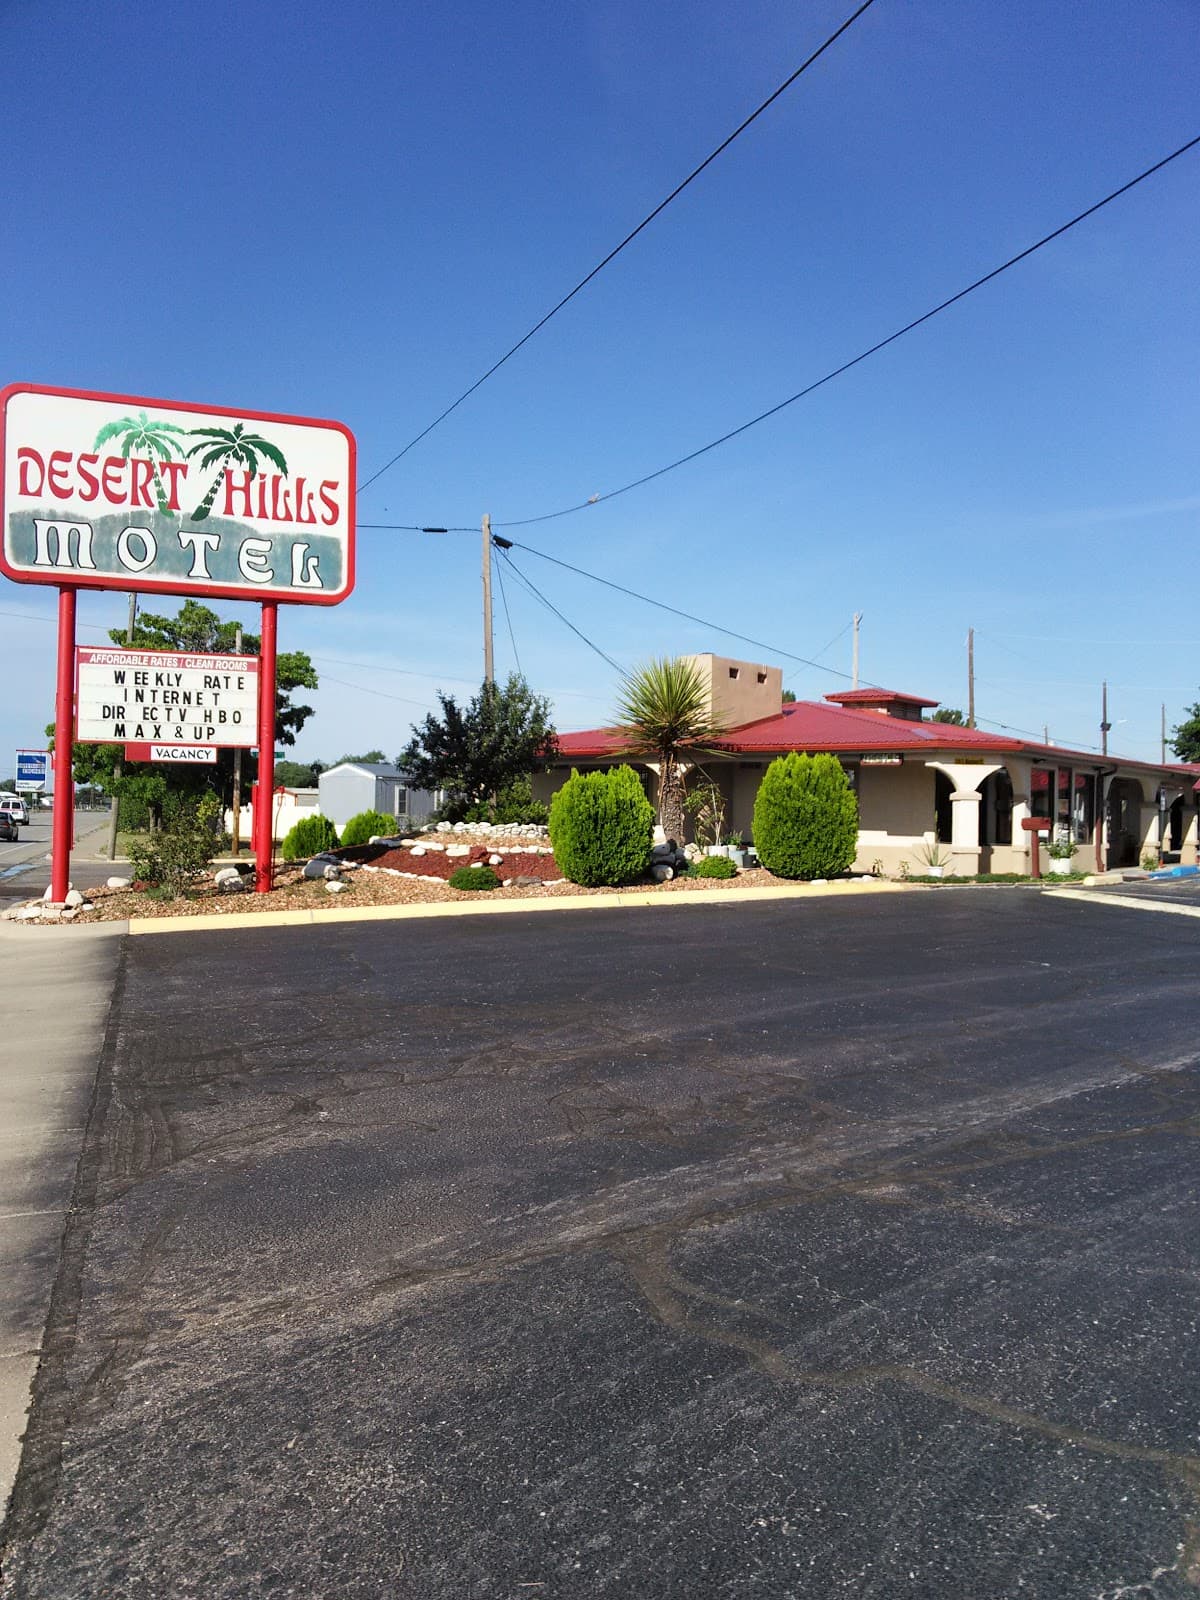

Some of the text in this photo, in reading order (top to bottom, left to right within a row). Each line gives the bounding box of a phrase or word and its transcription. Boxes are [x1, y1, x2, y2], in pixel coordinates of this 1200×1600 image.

[18, 447, 188, 511] DESERT
[32, 517, 324, 589] MOTEL
[90, 653, 148, 665] AFFORDABLE
[151, 656, 178, 668] RATES
[186, 658, 213, 669] CLEAN
[215, 660, 248, 671] ROOMS
[114, 670, 245, 690] WEEKLY RATE
[124, 688, 220, 706] INTERNET
[203, 709, 242, 724] HBO
[114, 723, 216, 741] MAX & UP
[155, 748, 212, 760] VACANCY
